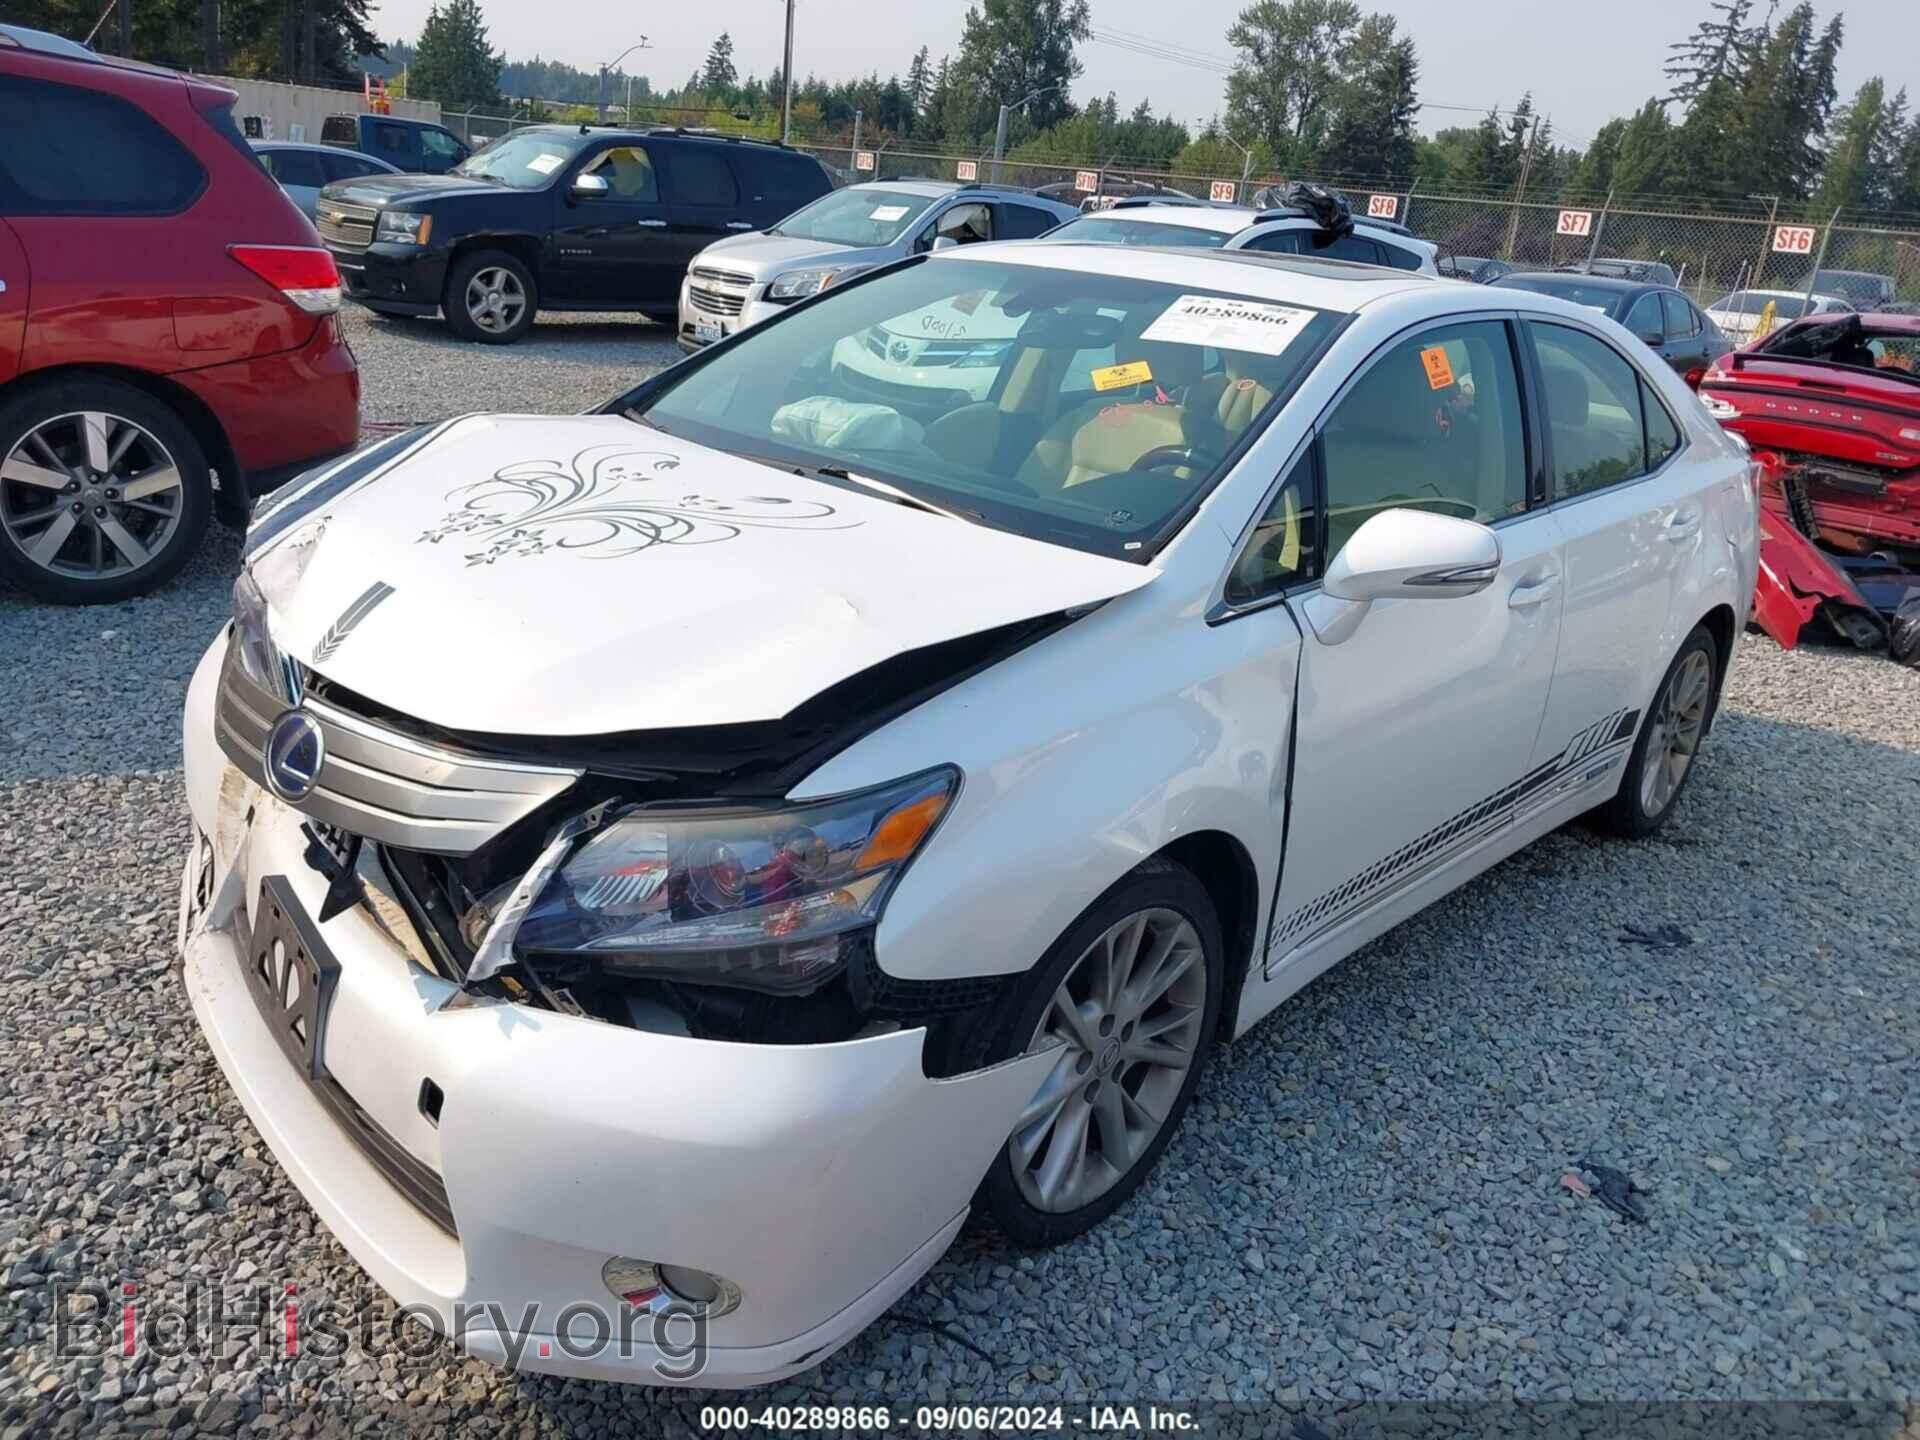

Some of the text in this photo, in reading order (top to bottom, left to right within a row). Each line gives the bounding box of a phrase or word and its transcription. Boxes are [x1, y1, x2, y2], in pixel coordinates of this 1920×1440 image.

[960, 163, 975, 178] SF11
[1077, 173, 1097, 190] SF10
[1212, 183, 1232, 200] SF9
[1371, 198, 1395, 215] SF8
[1561, 213, 1588, 233] SF7
[1776, 229, 1810, 250] SF6
[1183, 304, 1289, 326] 40289866
